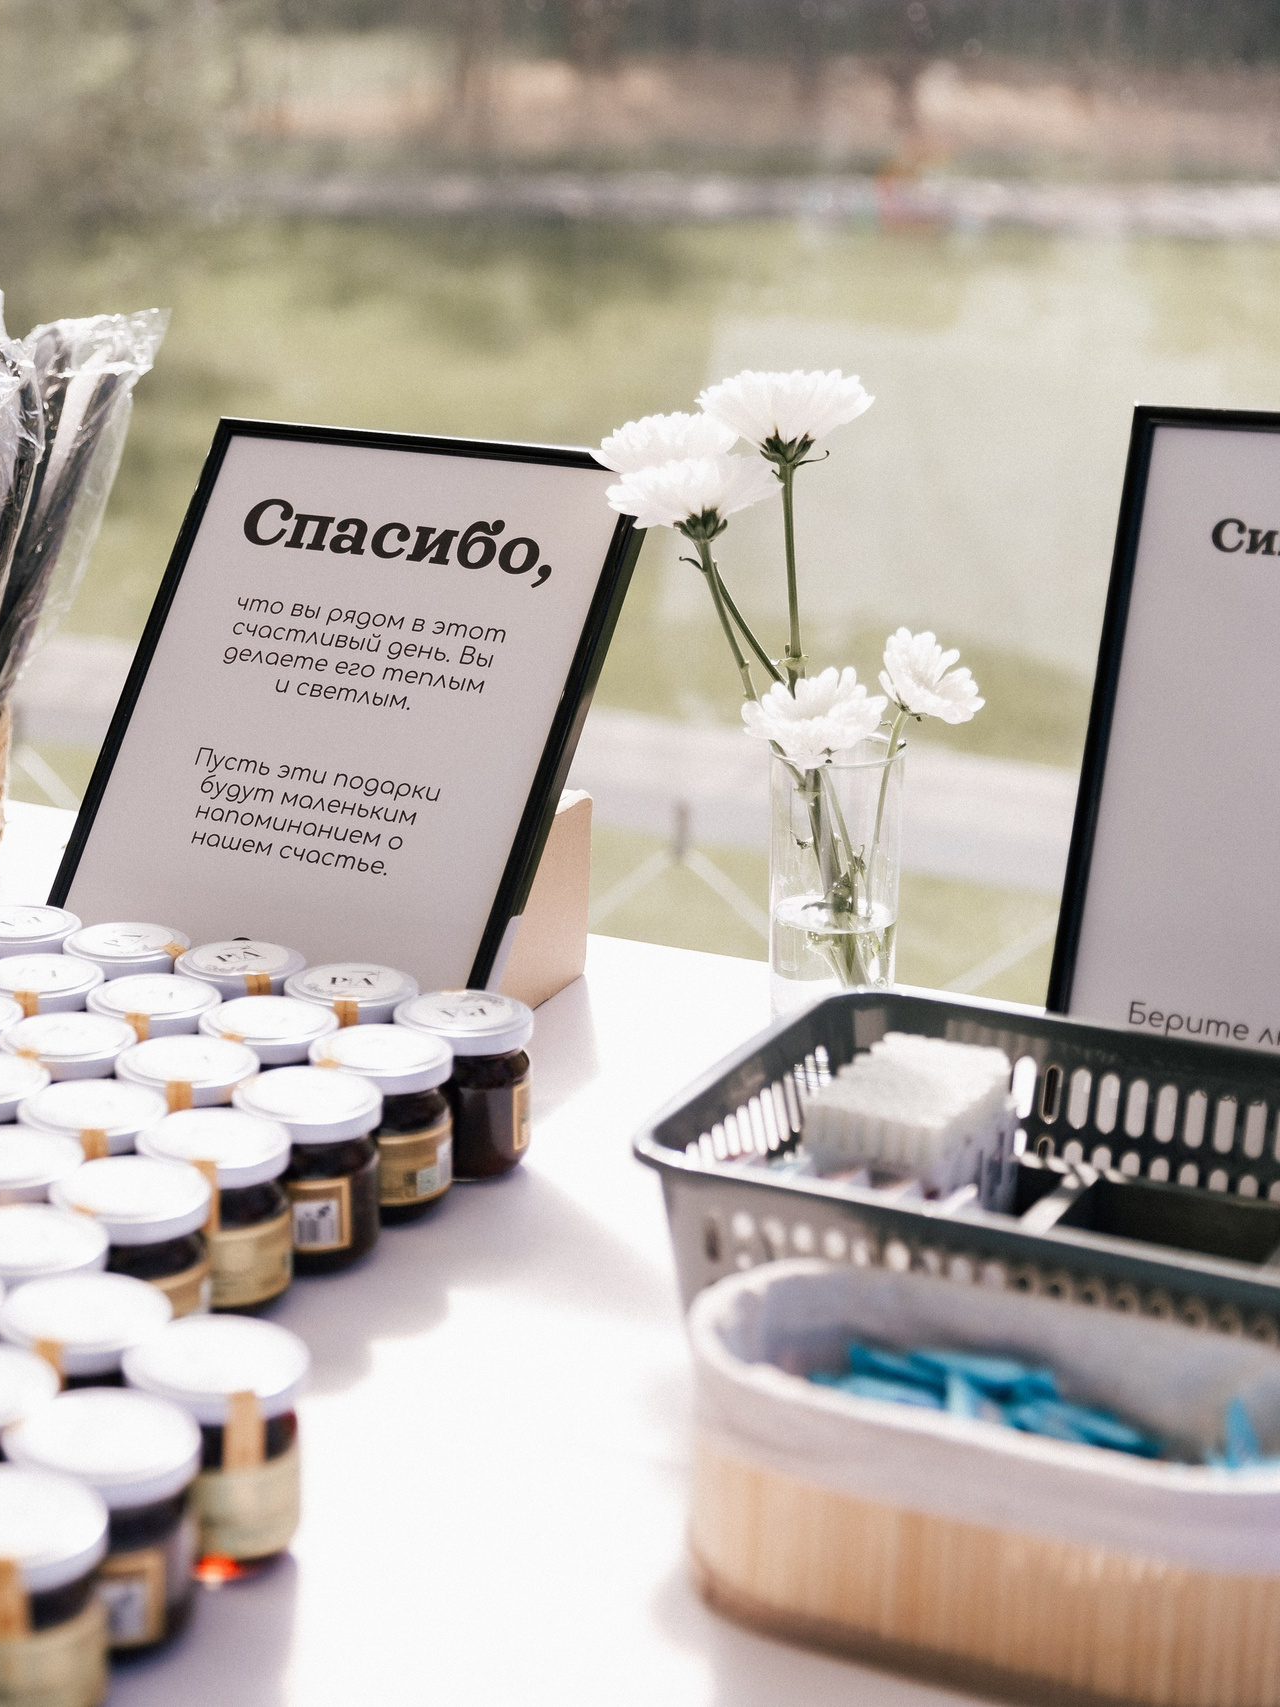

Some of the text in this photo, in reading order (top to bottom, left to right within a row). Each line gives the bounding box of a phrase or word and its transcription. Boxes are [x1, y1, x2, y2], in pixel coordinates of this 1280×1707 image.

[242, 498, 553, 589] Спасибо,
[1211, 517, 1280, 557] Си
[237, 596, 507, 644] что вы рядом в этот
[232, 621, 495, 669] счастливый день. Вы
[222, 646, 486, 694] делаете его теплым
[275, 678, 412, 711] и светлым.
[194, 746, 442, 802] Пусть эти подарки
[200, 774, 418, 826] будут маленьким
[195, 805, 404, 851] напоминанием о
[191, 831, 388, 877] нашем счастье.
[1128, 1000, 1280, 1047] Берите л
